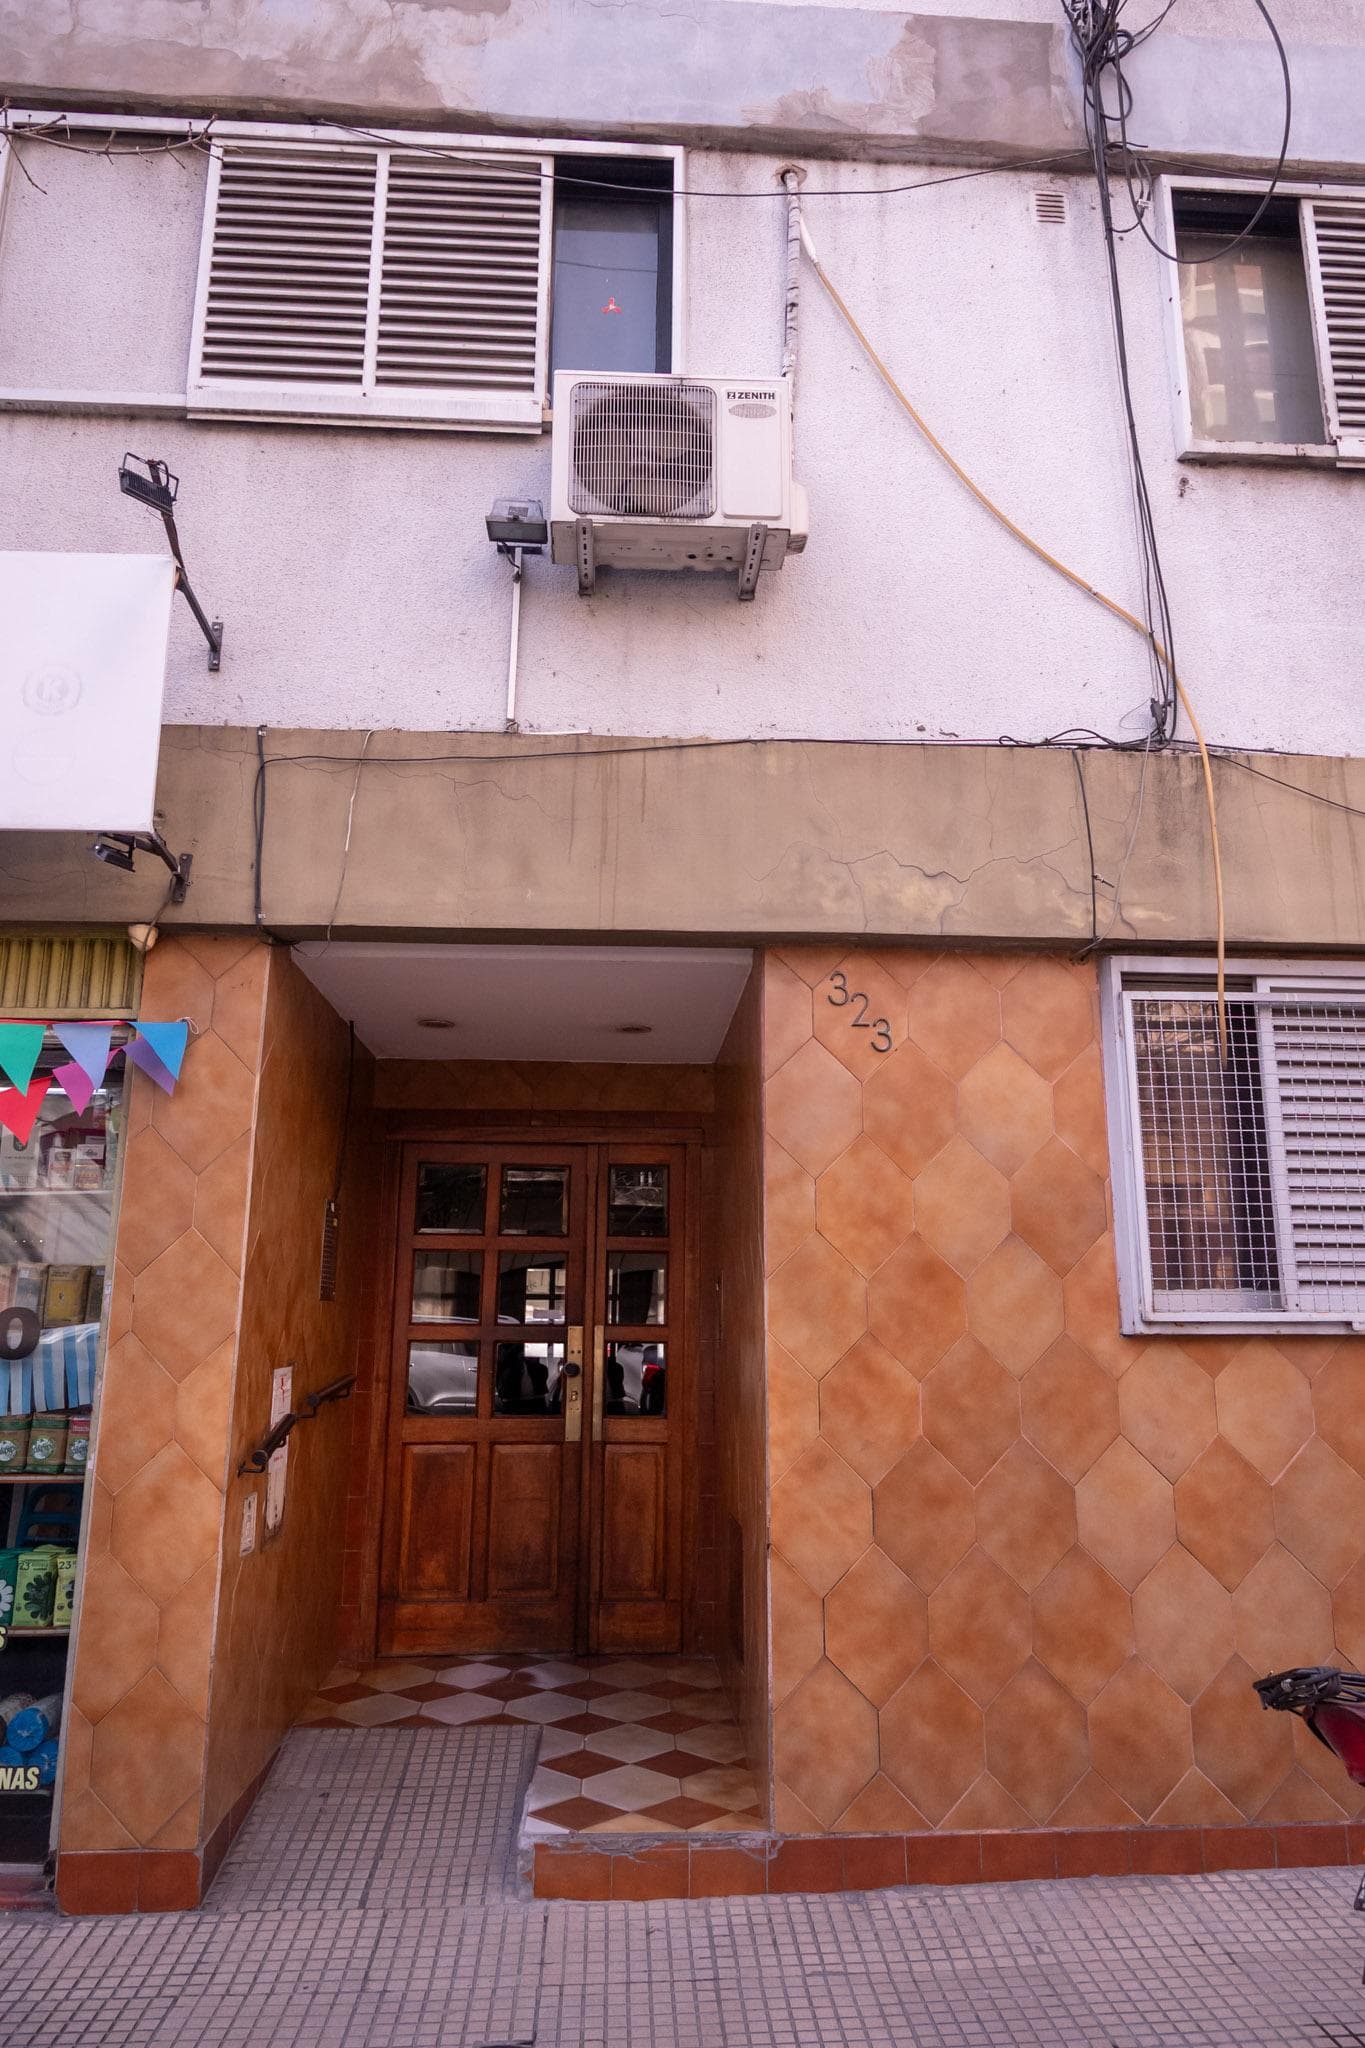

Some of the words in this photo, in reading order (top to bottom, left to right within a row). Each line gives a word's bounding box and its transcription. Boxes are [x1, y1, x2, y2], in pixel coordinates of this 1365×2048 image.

[737, 391, 776, 400] ZENITH
[827, 971, 893, 1053] 323
[0, 1766, 40, 1791] NAS
